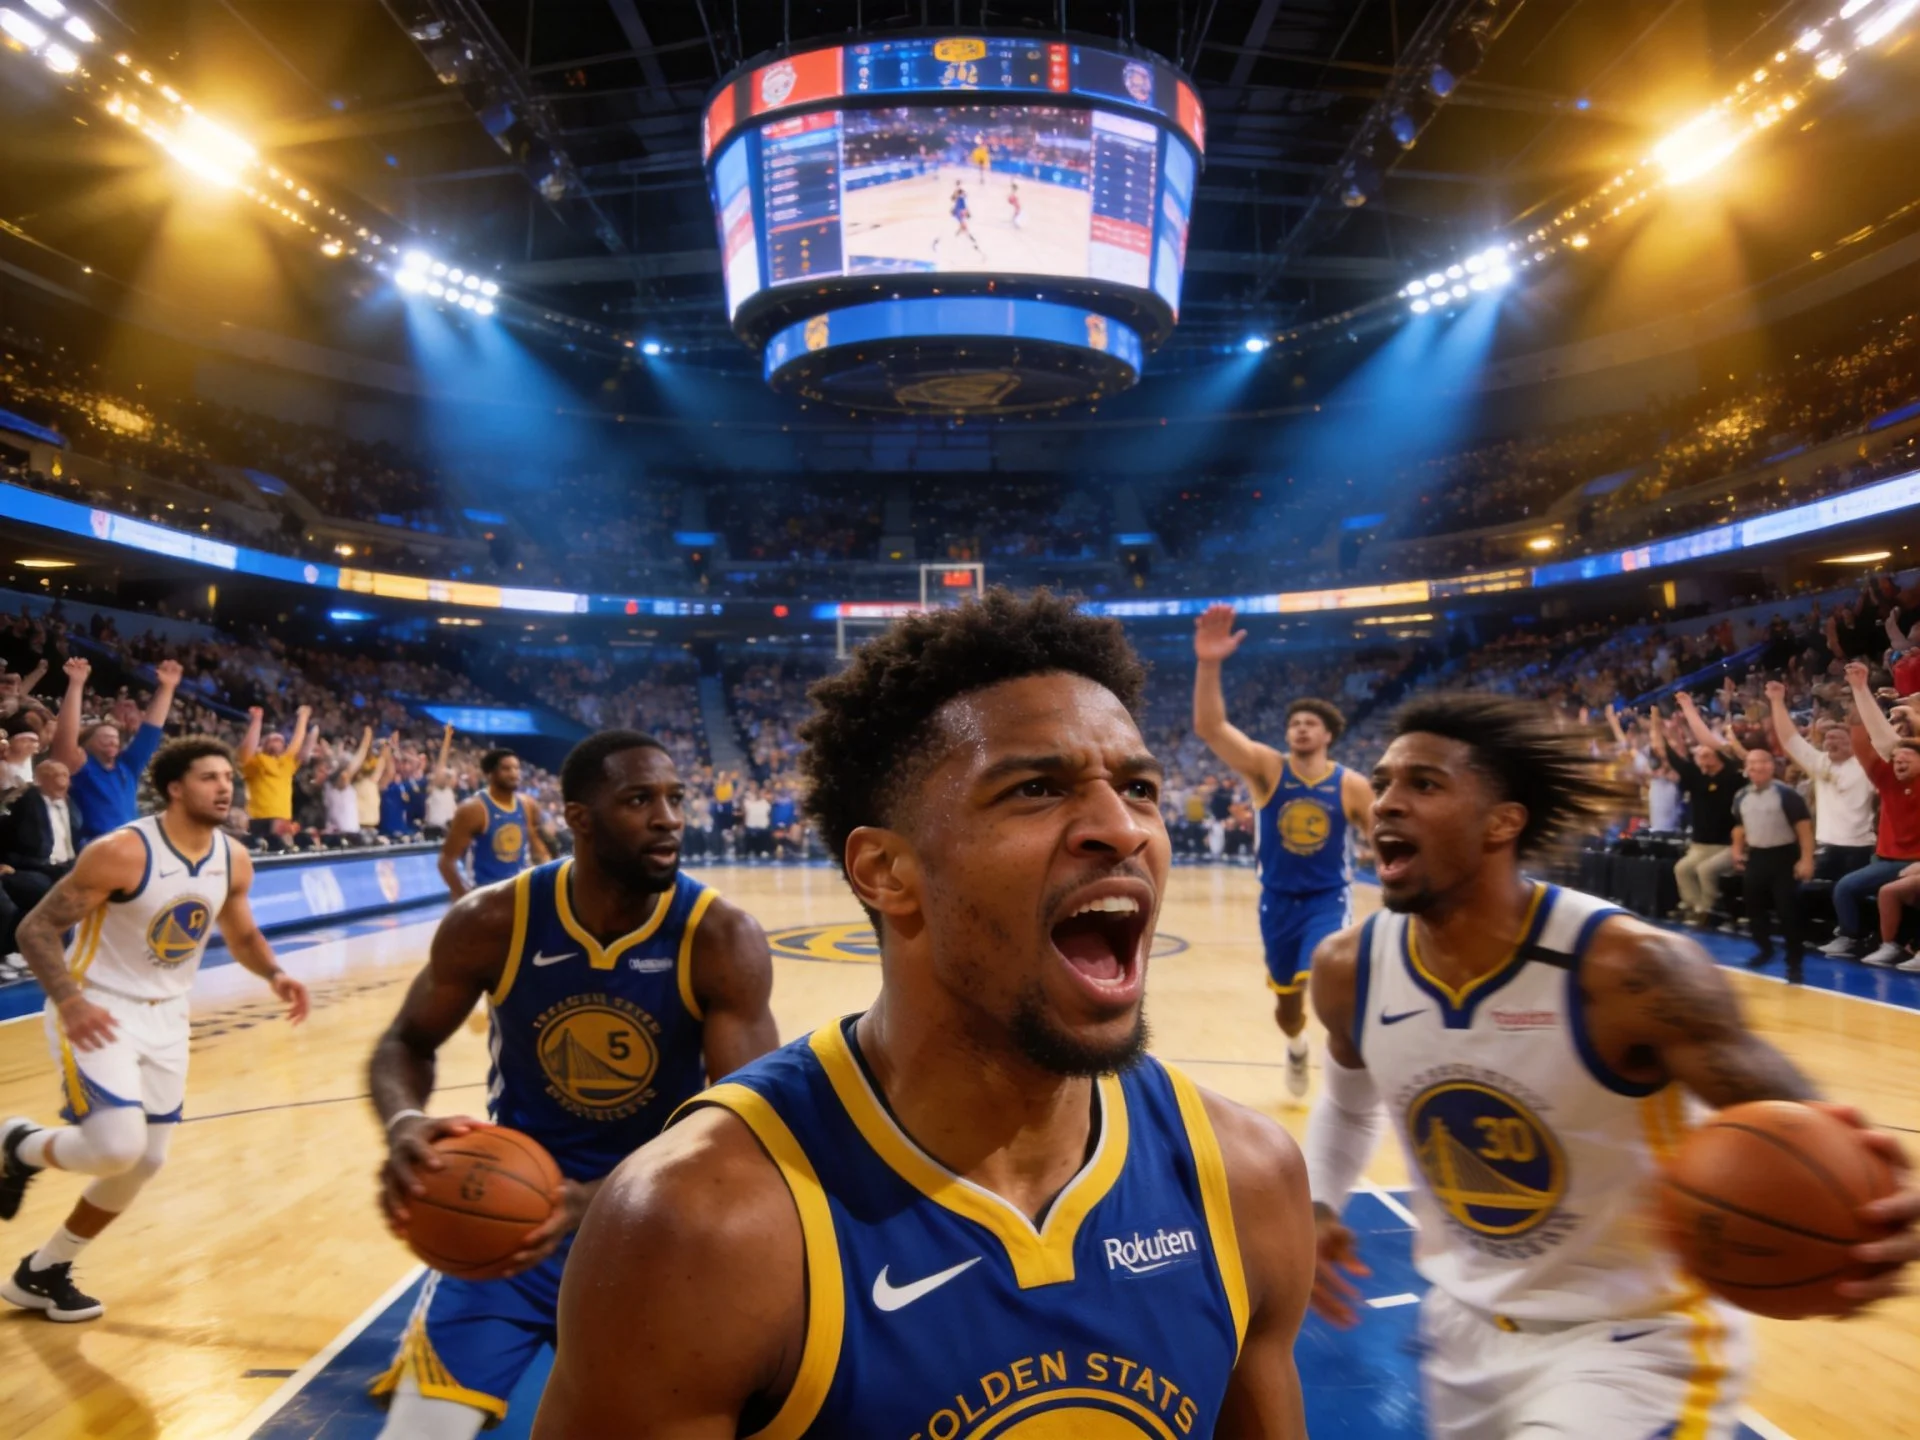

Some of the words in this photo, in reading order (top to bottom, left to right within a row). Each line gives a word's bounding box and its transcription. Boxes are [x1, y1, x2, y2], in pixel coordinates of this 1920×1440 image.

[607, 1031, 631, 1061] 5
[1473, 1115, 1537, 1163] 30
[909, 1350, 1068, 1440] OLDEN
[1086, 1352, 1199, 1435] STATS
